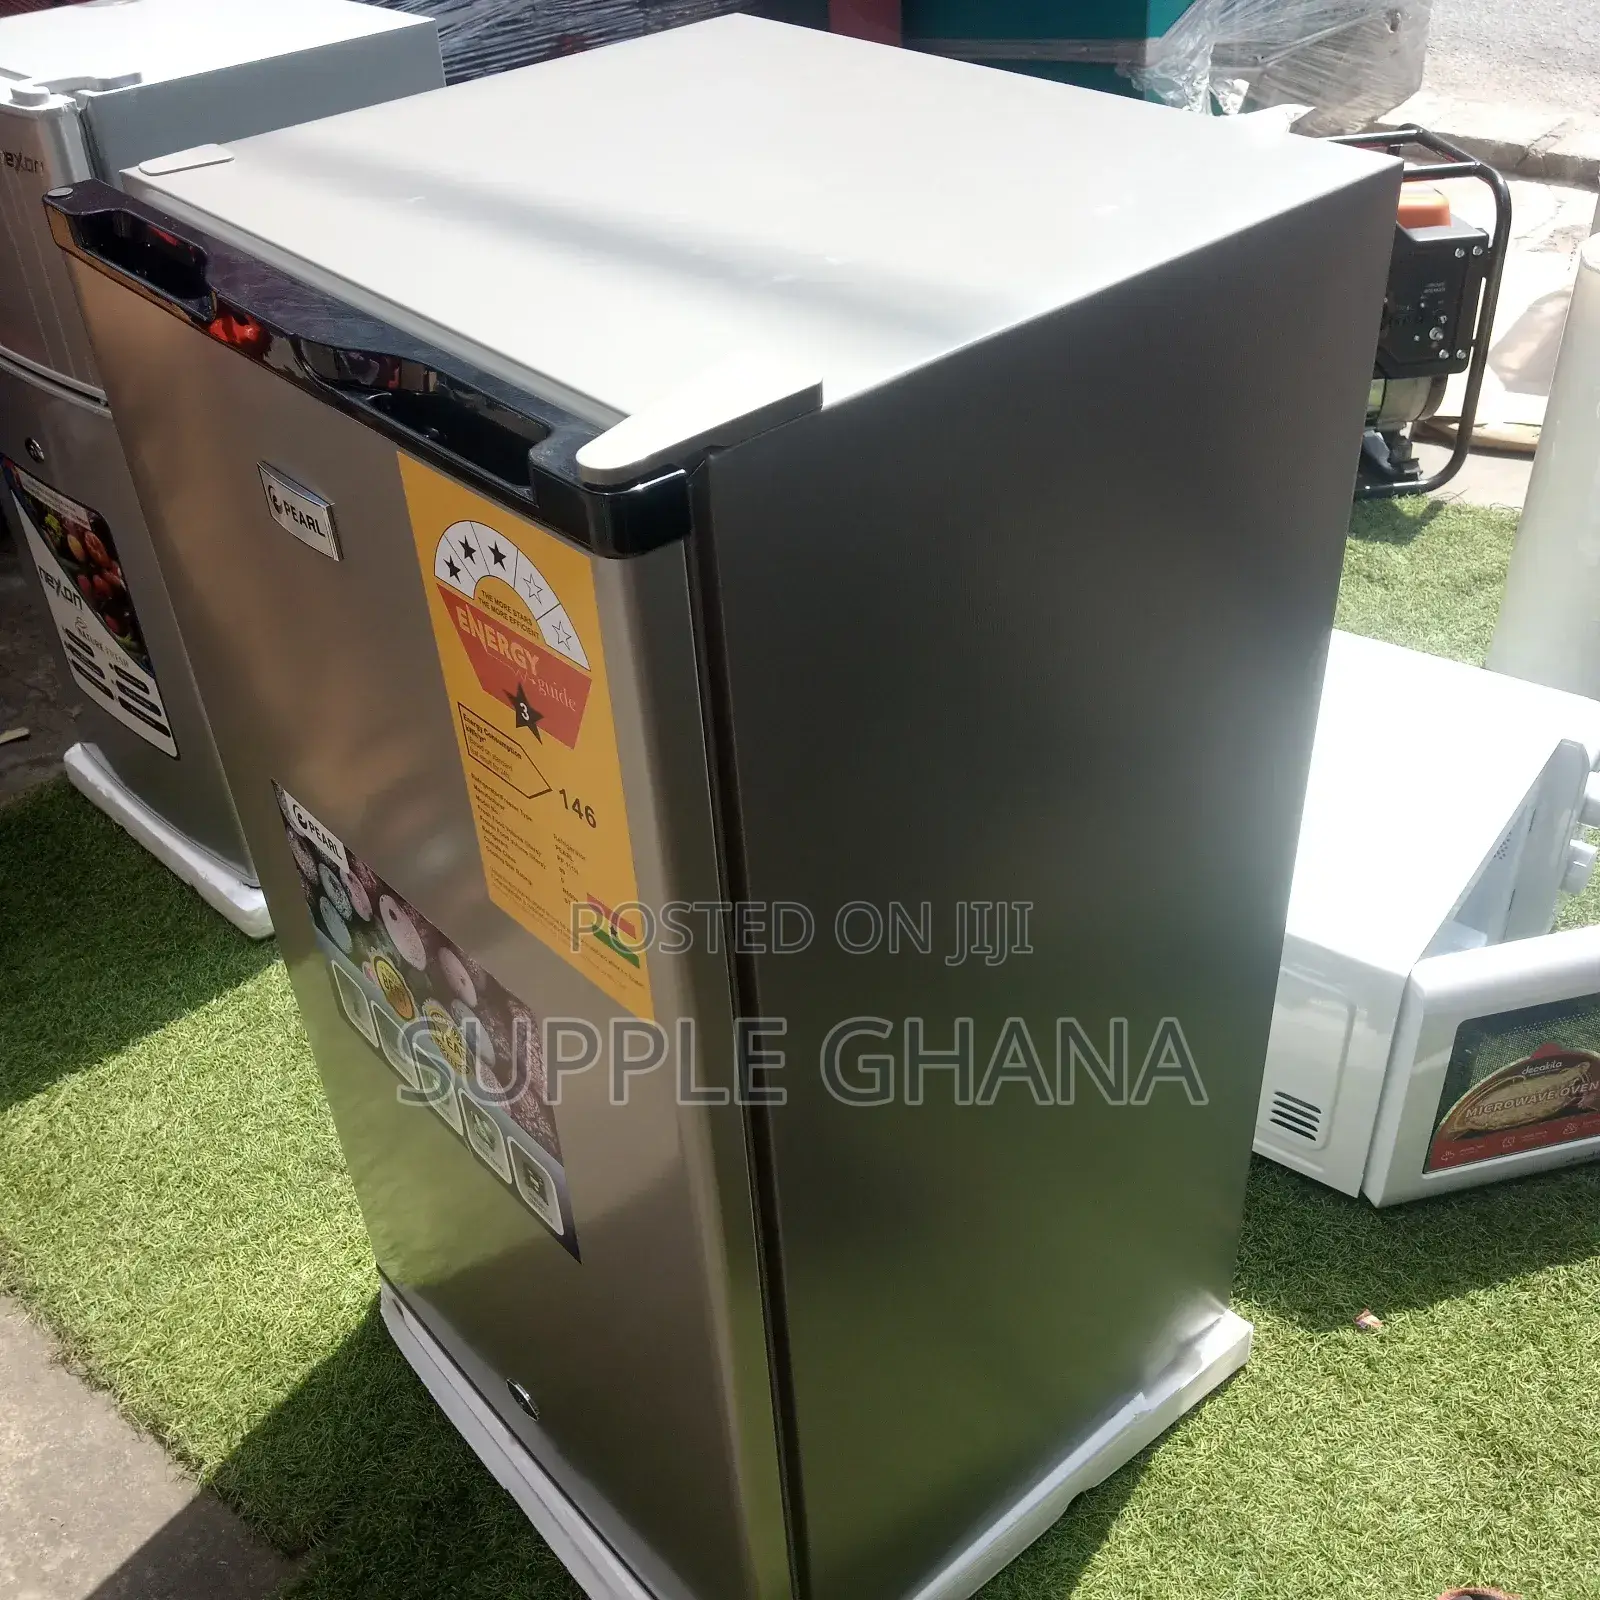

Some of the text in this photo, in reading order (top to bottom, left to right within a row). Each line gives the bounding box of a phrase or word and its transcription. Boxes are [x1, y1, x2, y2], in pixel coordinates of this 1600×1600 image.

[283, 500, 326, 538] PEARL
[478, 596, 540, 639] THE MORE EFFICIENT
[481, 590, 533, 626] THE MORE STARS
[456, 603, 540, 676] ENERGY
[520, 702, 530, 721] 3
[538, 679, 576, 712] guide
[463, 713, 522, 759] Energy Consumption
[559, 788, 597, 828] 146
[308, 820, 343, 861] PEARL
[1521, 1060, 1563, 1076] decakila
[1465, 1081, 1600, 1118] MICROWAVE OVEN
